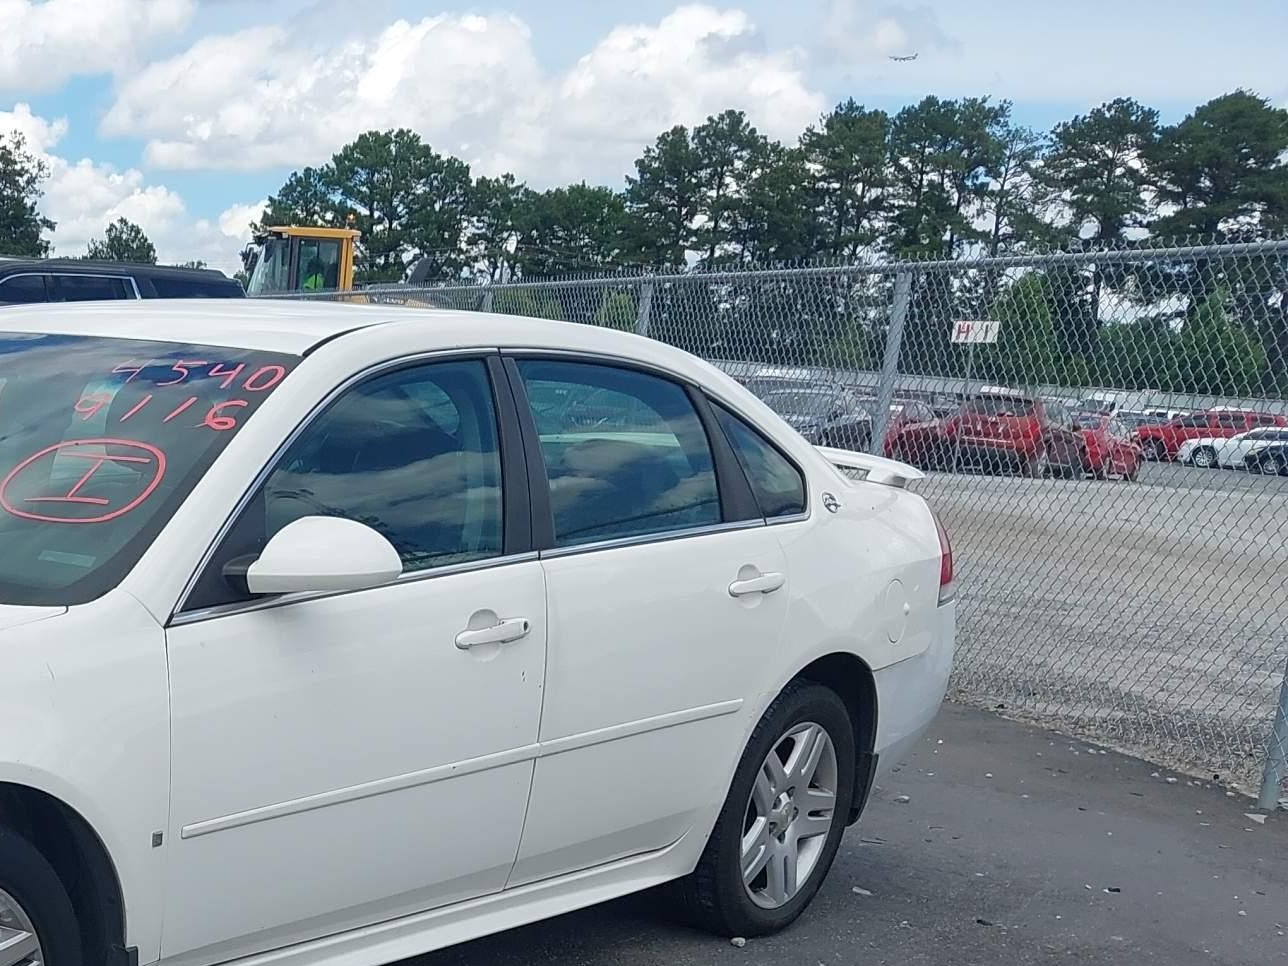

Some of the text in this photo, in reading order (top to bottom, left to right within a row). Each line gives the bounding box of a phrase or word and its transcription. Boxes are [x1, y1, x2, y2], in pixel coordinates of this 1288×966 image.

[955, 323, 971, 340] H
[112, 359, 287, 392] 4540
[73, 394, 249, 431] 9116
